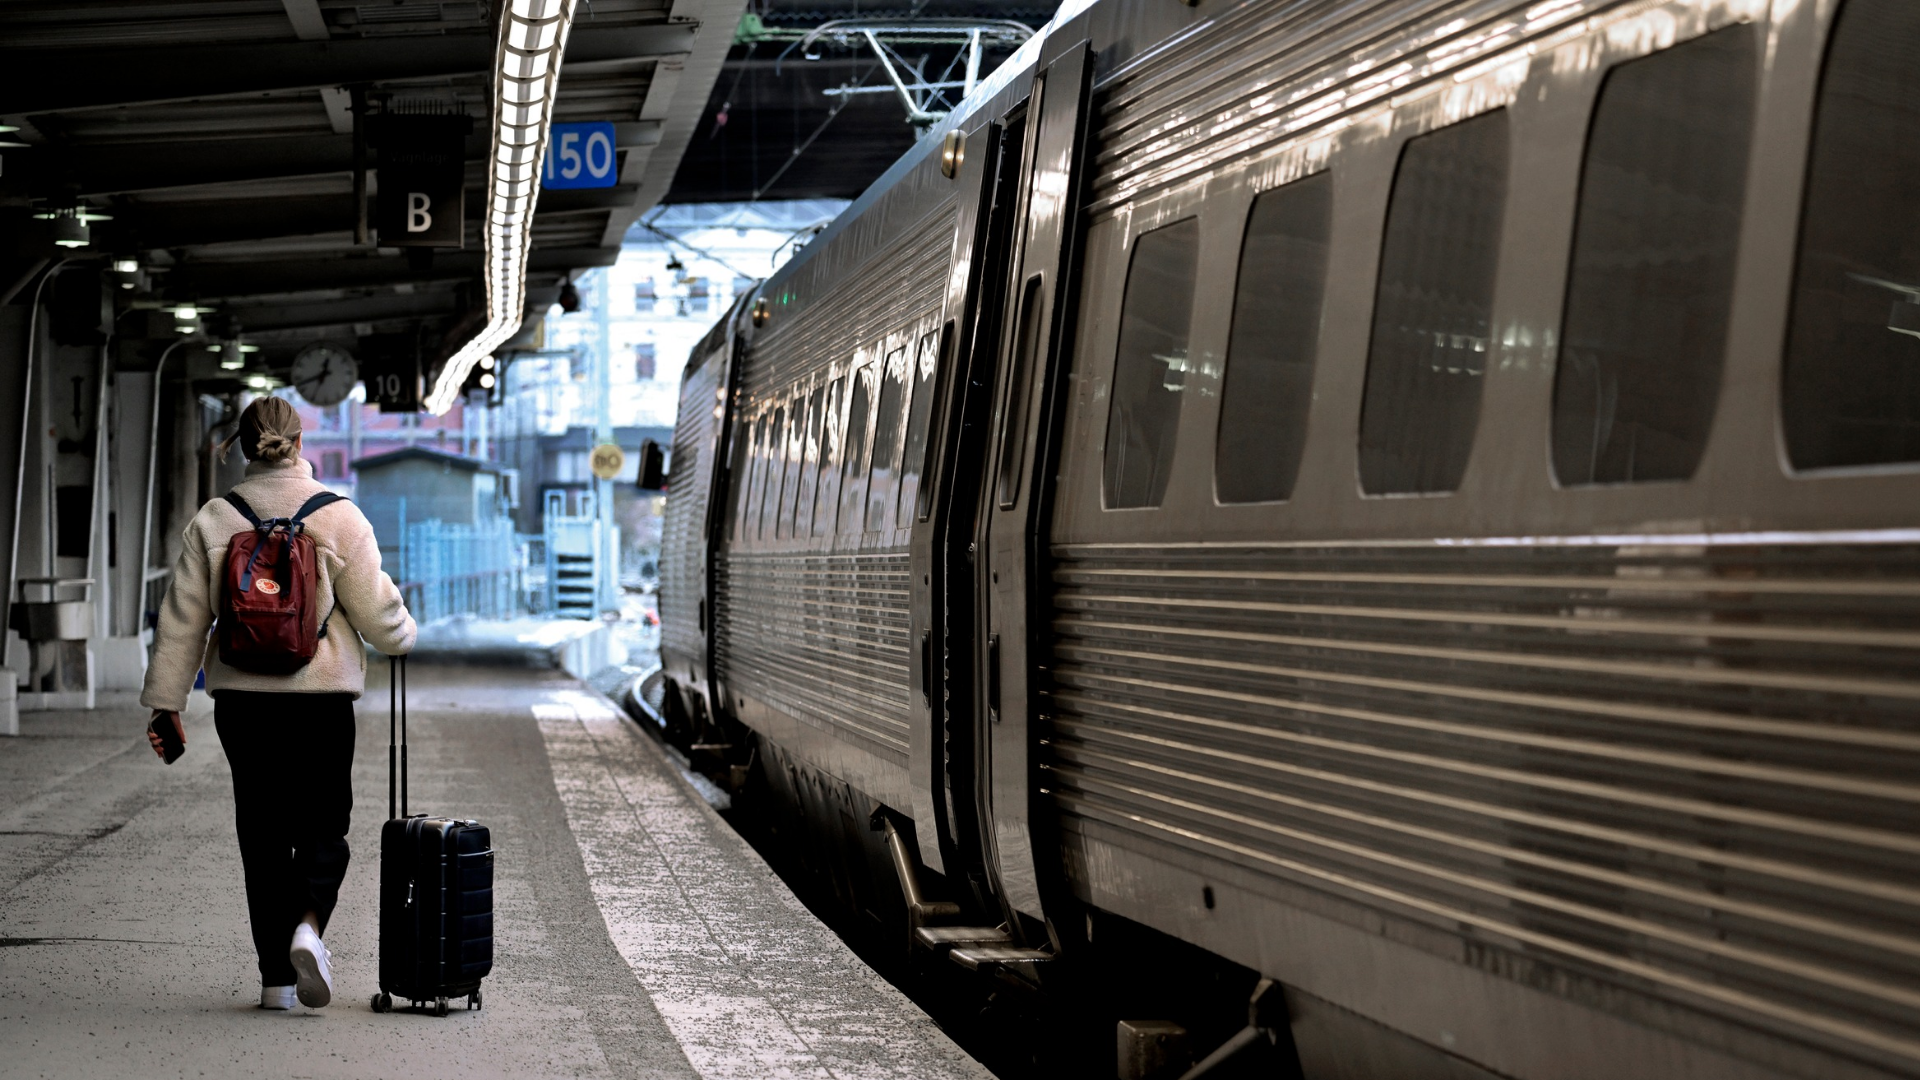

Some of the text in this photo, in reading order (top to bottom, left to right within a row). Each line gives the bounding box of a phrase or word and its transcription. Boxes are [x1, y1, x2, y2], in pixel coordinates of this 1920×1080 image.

[546, 131, 612, 180] 150
[407, 192, 433, 233] B
[375, 374, 401, 396] 10
